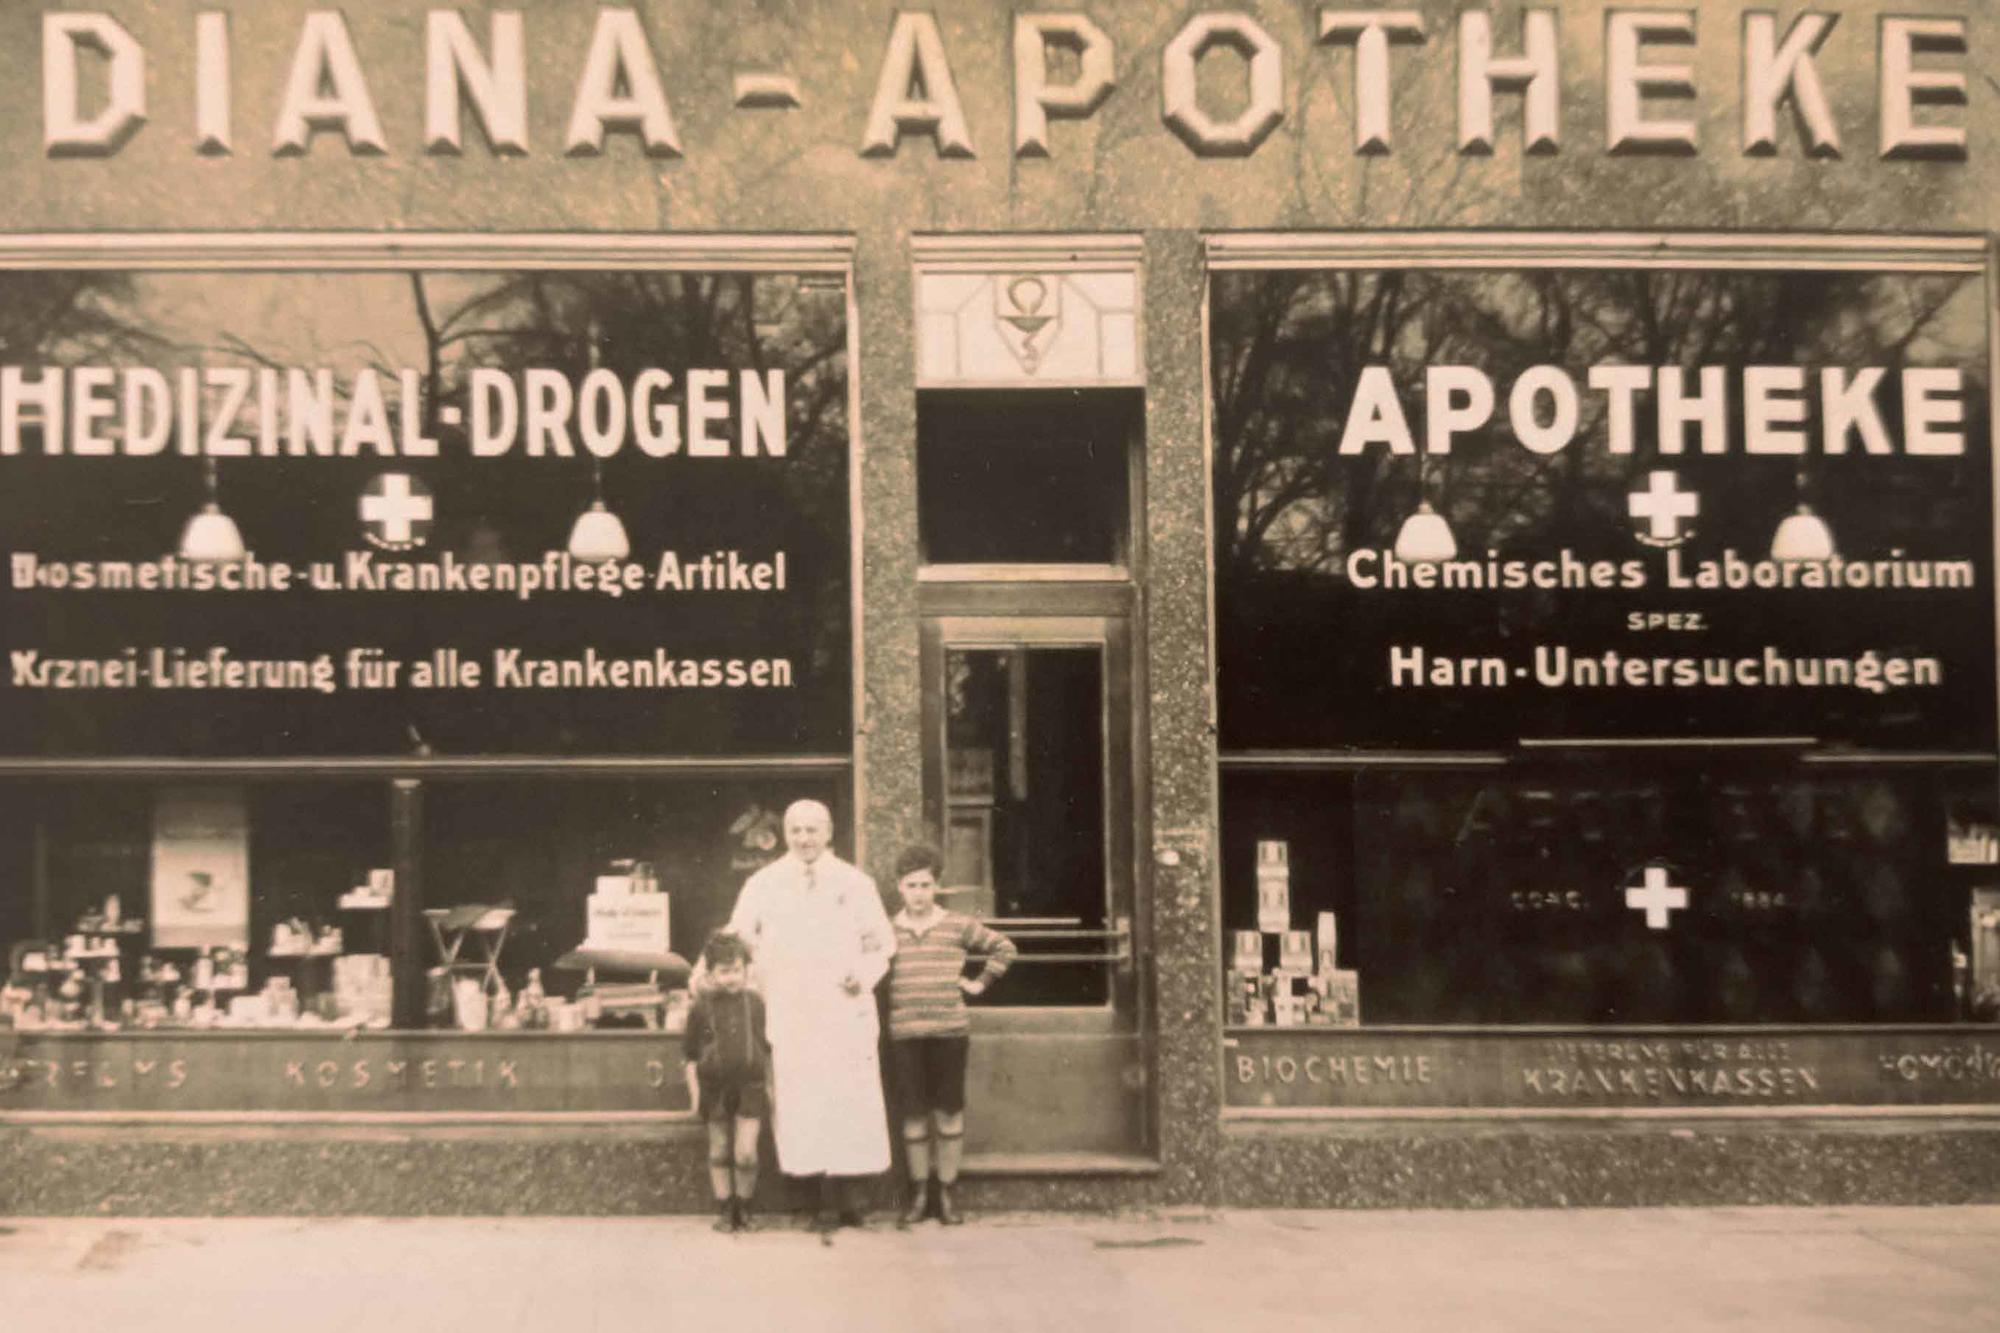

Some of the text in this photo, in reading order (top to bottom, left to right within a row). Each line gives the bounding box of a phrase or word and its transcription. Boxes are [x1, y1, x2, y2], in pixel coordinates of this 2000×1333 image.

[1339, 364, 1967, 456] APOTHEKE
[1347, 549, 1974, 589] Chemisches Laboratorium
[346, 647, 401, 688] für
[410, 648, 482, 688] alle
[494, 647, 793, 688] Krankenkassen
[284, 1058, 519, 1090] KOSMETIK
[1235, 1054, 1433, 1084] BIOCHEMIE
[1522, 1066, 1820, 1096] KRANKENKASSEN
